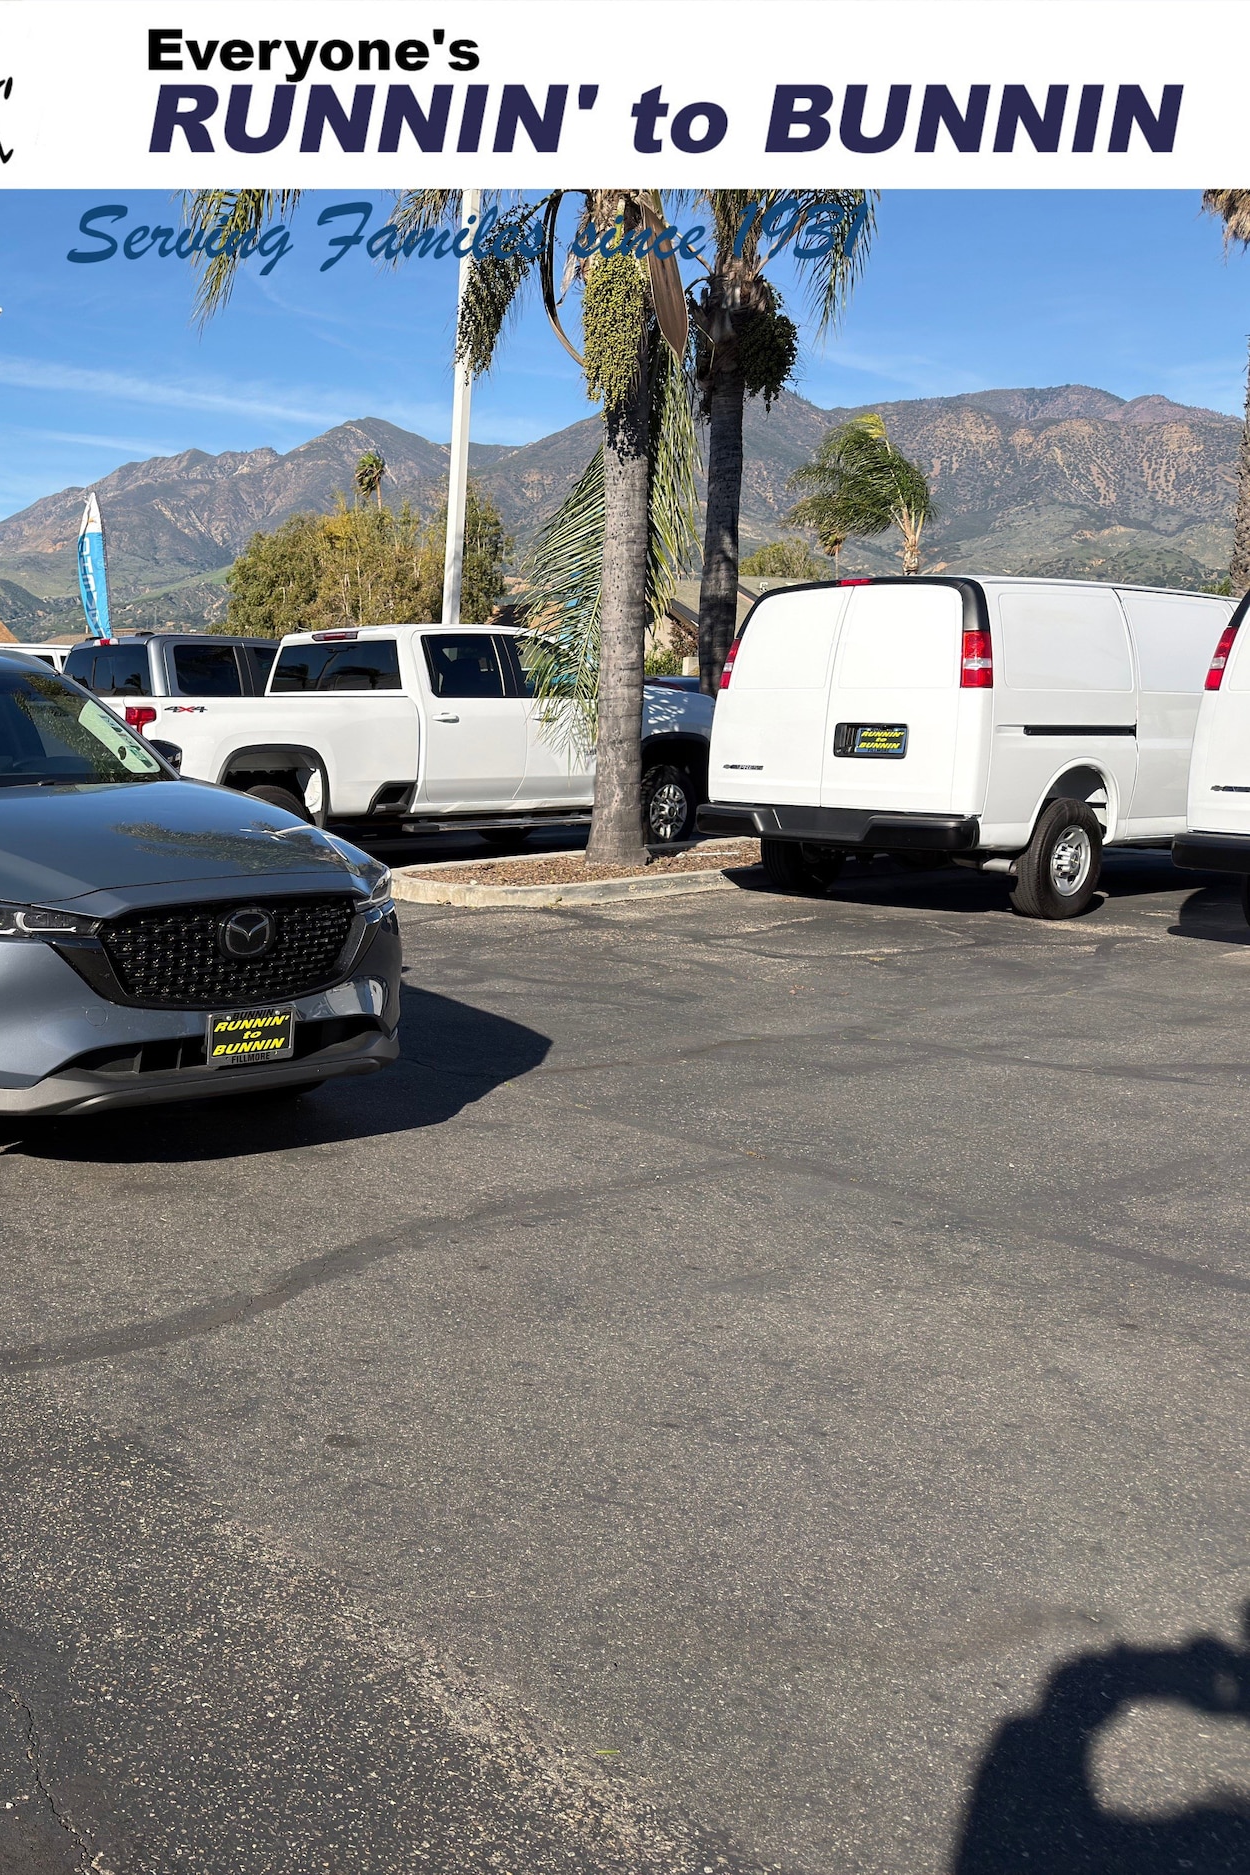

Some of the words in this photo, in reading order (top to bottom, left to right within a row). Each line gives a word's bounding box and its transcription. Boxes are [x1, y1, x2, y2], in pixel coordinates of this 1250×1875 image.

[858, 741, 901, 749] BUNNIN
[213, 1014, 291, 1032] RUNNIN'
[242, 1030, 262, 1040] to
[212, 1037, 286, 1056] BUNNIN
[231, 1052, 271, 1064] FILLMORE
